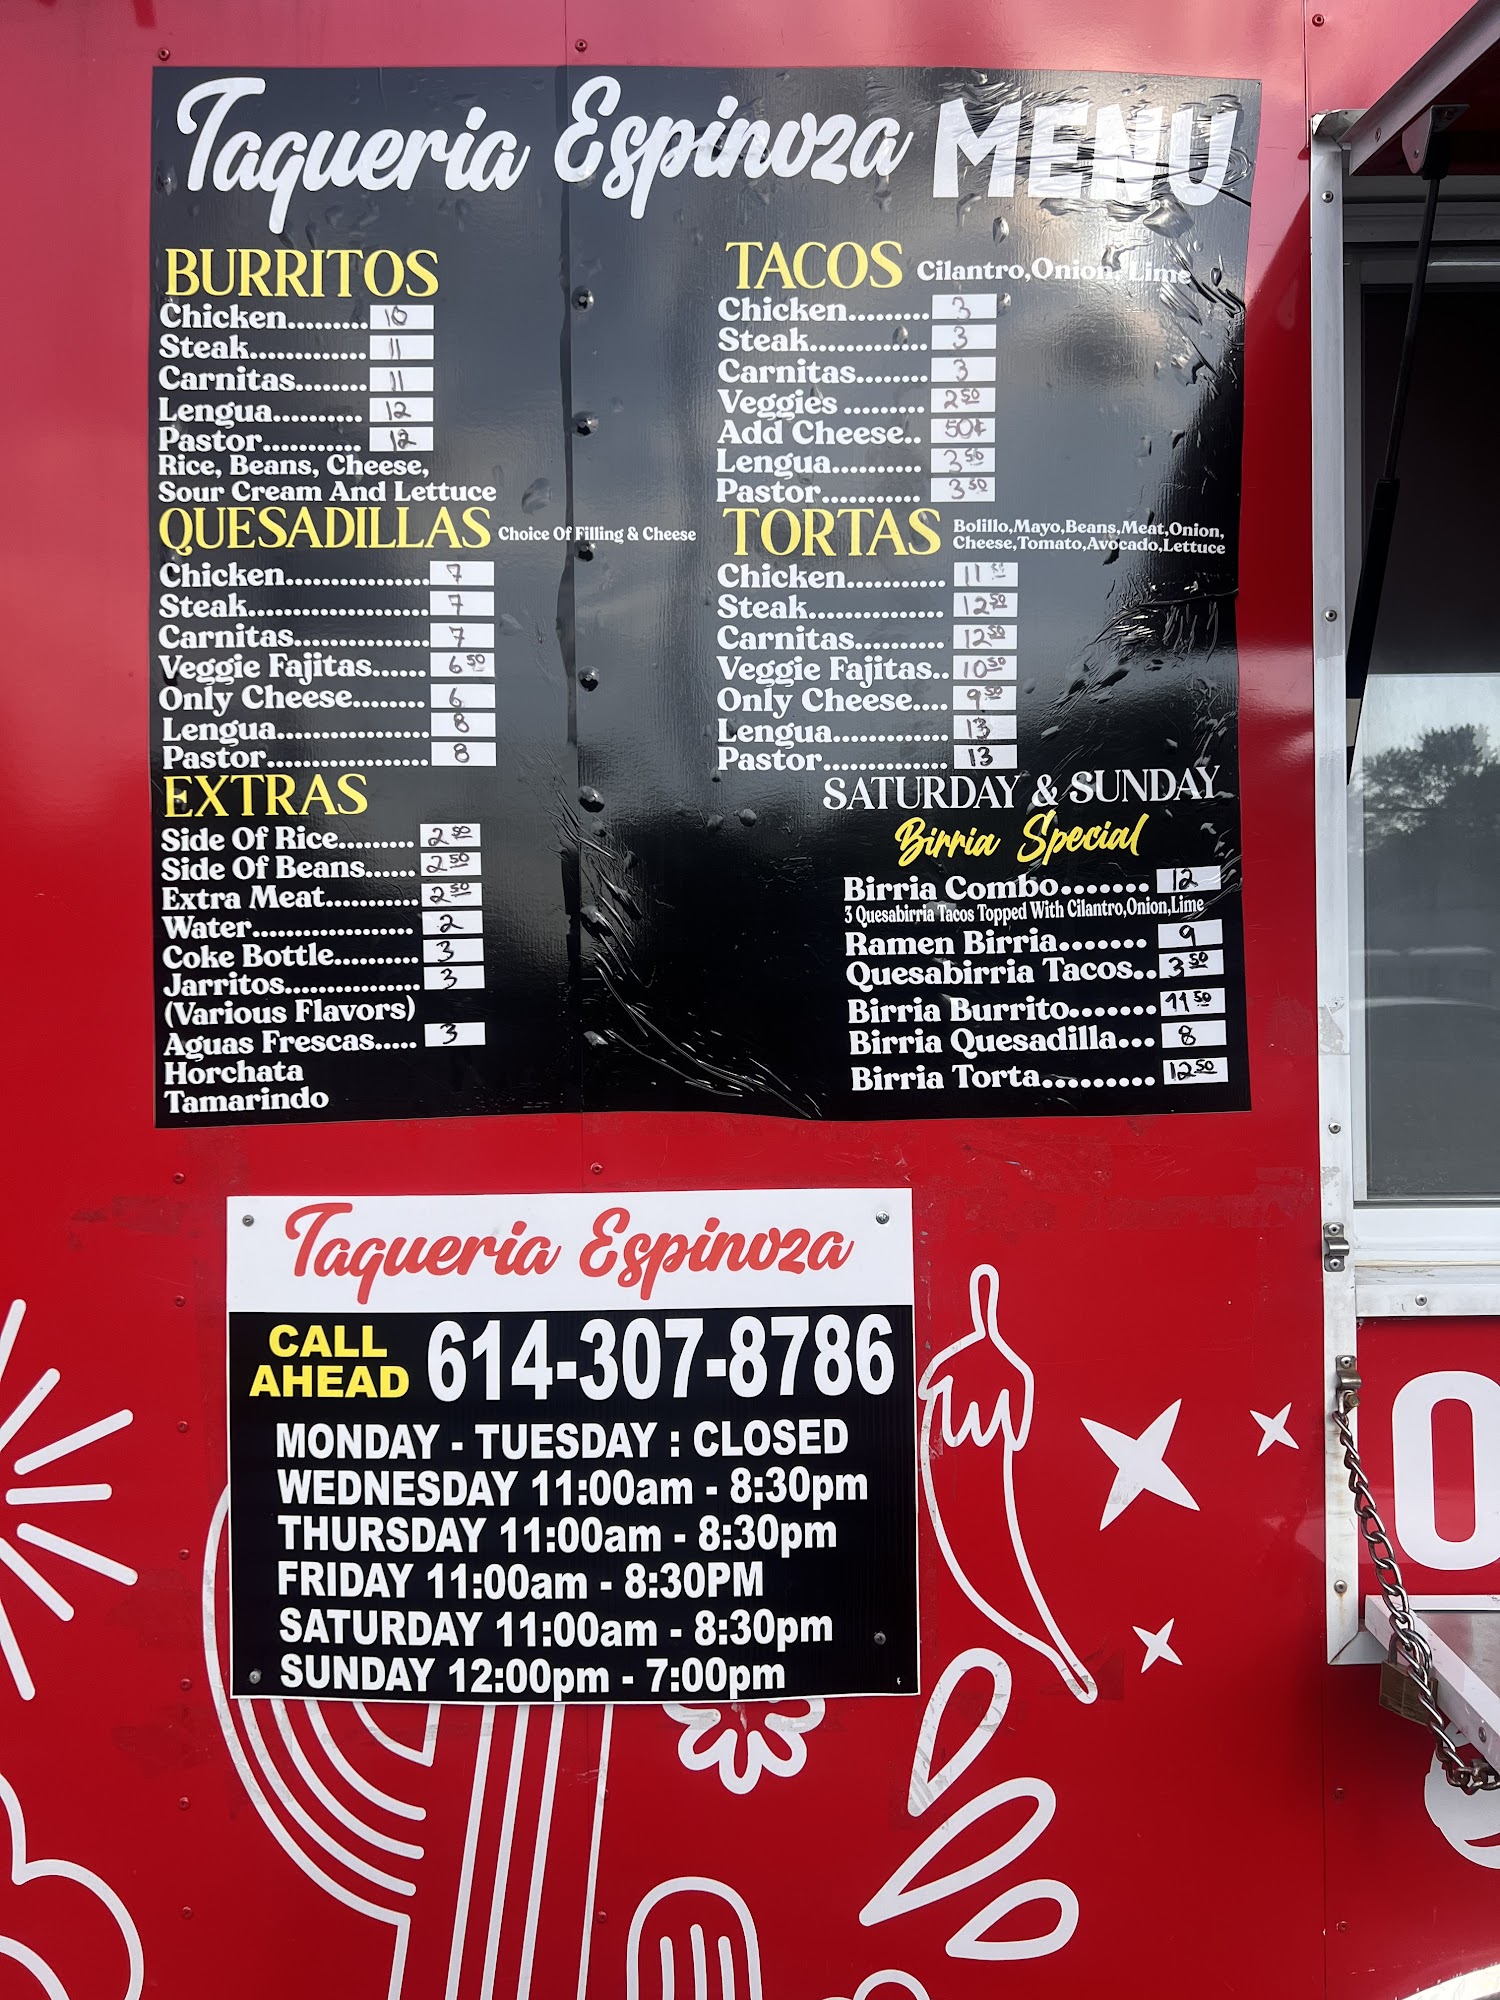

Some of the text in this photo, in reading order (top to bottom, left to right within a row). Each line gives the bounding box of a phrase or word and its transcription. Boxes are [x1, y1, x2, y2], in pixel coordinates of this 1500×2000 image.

[177, 76, 1238, 234] Taqueria Espinoza MENU
[165, 249, 438, 297] BURRITOS
[726, 241, 902, 289] TACOS
[1128, 261, 1192, 285] Lime
[385, 306, 407, 326] 10
[952, 297, 972, 320] 3
[390, 338, 401, 357] 11
[953, 327, 968, 348] 3
[390, 370, 403, 391] 11
[953, 359, 968, 381] 3
[386, 401, 411, 420] 12
[717, 389, 837, 420] Veggies
[390, 430, 416, 451] 12
[717, 420, 783, 444] Add
[159, 454, 429, 478] Rice, Beans, Cheese,
[159, 481, 496, 502] Sour Cream And Lettuce
[160, 507, 696, 556] QUESADILLAS Choice Of Filling & Cheese
[723, 508, 941, 556] TORTAS
[447, 564, 462, 584] 7
[448, 594, 463, 615] 7
[449, 626, 465, 647] 7
[158, 654, 260, 685] Veggie
[716, 656, 820, 687] Veggie
[159, 686, 233, 717] Only
[449, 688, 464, 708] 6
[717, 687, 793, 719] Only
[454, 713, 469, 733] 8
[967, 717, 990, 738] 13
[453, 743, 469, 763] 8
[968, 747, 993, 766] 13
[164, 773, 367, 817] EXTRAS
[823, 766, 1220, 810] SATURDAY & SUNDAY
[161, 828, 225, 851] Side
[232, 826, 269, 850] Of
[895, 811, 1149, 866] Birria Special
[161, 857, 225, 881] Side
[232, 855, 269, 879] Of
[162, 887, 241, 910] Extra
[844, 876, 937, 901] Birria
[1172, 868, 1199, 892] 12
[440, 914, 463, 933] 2
[845, 906, 852, 923] 3
[856, 903, 935, 928] Quesabirria
[934, 901, 974, 922] Tacos
[977, 902, 1027, 926] Topped
[1030, 900, 1064, 919] With
[163, 945, 234, 969] Coke
[436, 941, 455, 963] 3
[845, 932, 955, 956] Ramen
[1179, 925, 1196, 946] 9
[440, 968, 458, 990] 3
[846, 958, 1034, 992] Quesabirria
[165, 995, 415, 1028] (Various Flavors)
[848, 997, 941, 1023] Birria
[164, 1033, 254, 1062] Aguas
[439, 1023, 457, 1044] 3
[849, 1028, 942, 1055] Birria
[1178, 1025, 1196, 1045] 8
[165, 1060, 304, 1084] Horchata
[851, 1065, 944, 1090] Birria
[164, 1086, 329, 1113] Tamarindo
[285, 1203, 854, 1304] Taqueria Espinoza
[269, 1325, 387, 1357] CALL
[428, 1314, 894, 1401] 614-307-8786
[250, 1365, 409, 1397] AHEAD
[277, 1419, 848, 1459] MONDAY TUESDAY CLOSED
[278, 1466, 867, 1510] WEDNESDAY 11:00am 8:30pm
[278, 1514, 836, 1558] THURSDAY 11:00am 8:30pm
[279, 1561, 763, 1599] FRIDAY 11:00am 8:30PM
[280, 1608, 832, 1652] SATURDAY 11:00am 8:30pm
[281, 1654, 786, 1701] SUNDAY 12:00pm 7:00pm
